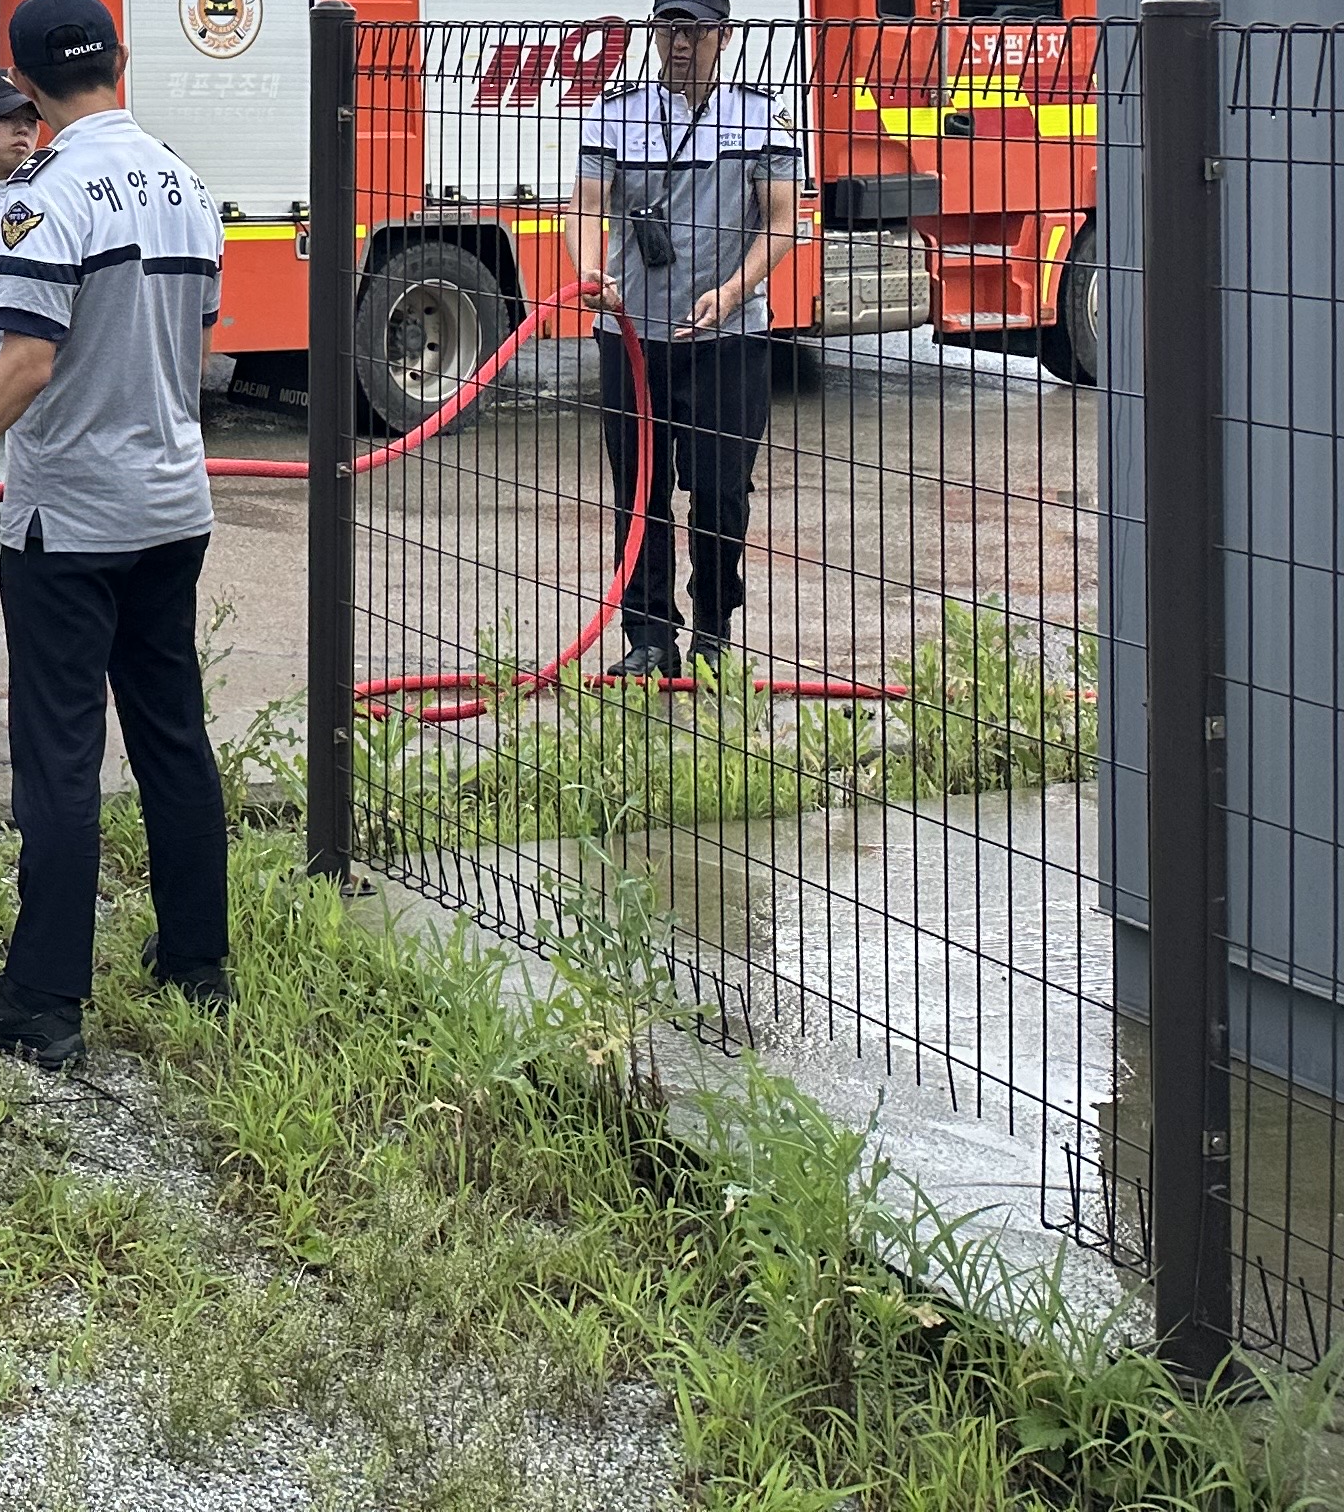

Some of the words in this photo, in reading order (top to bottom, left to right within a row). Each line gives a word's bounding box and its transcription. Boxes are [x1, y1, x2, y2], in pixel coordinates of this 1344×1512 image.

[64, 41, 104, 57] POLICE
[470, 15, 628, 108] 119
[168, 72, 281, 98] 펌프구조대
